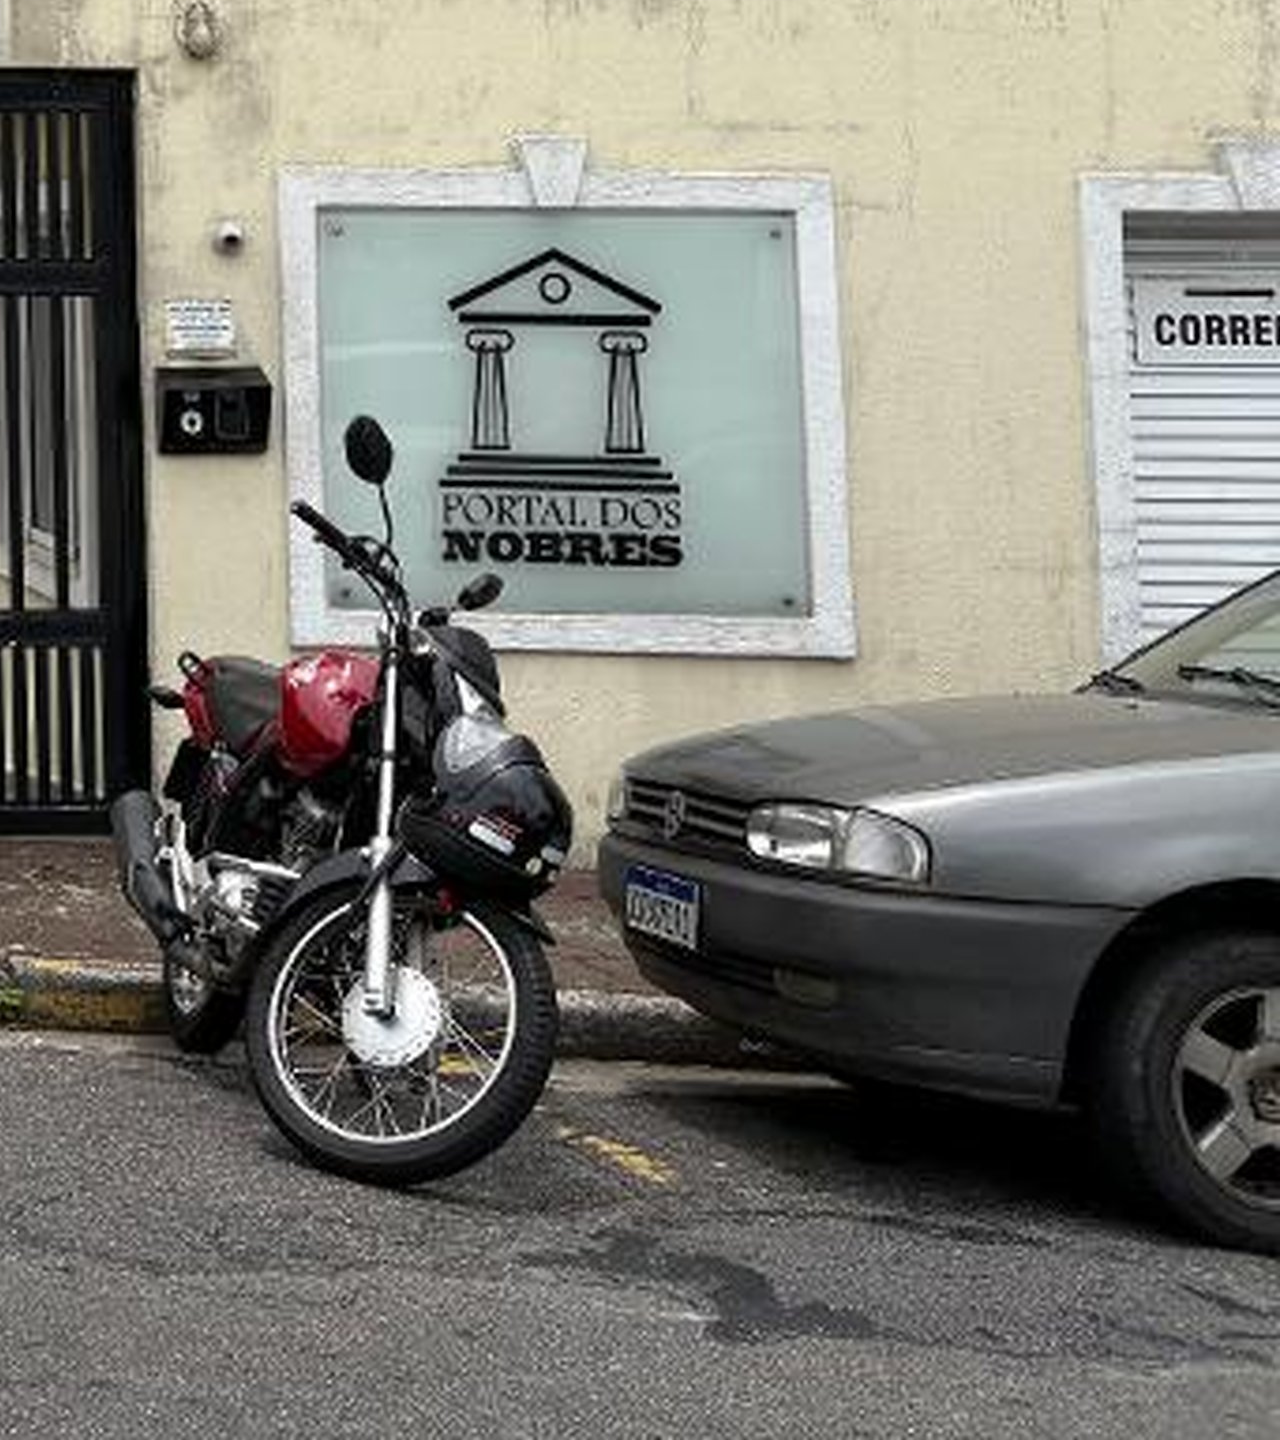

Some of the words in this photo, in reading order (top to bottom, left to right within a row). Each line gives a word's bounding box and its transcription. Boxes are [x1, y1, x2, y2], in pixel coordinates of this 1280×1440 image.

[442, 493, 587, 528] PORTAL
[599, 497, 682, 530] DOS
[441, 530, 684, 567] NOBRES
